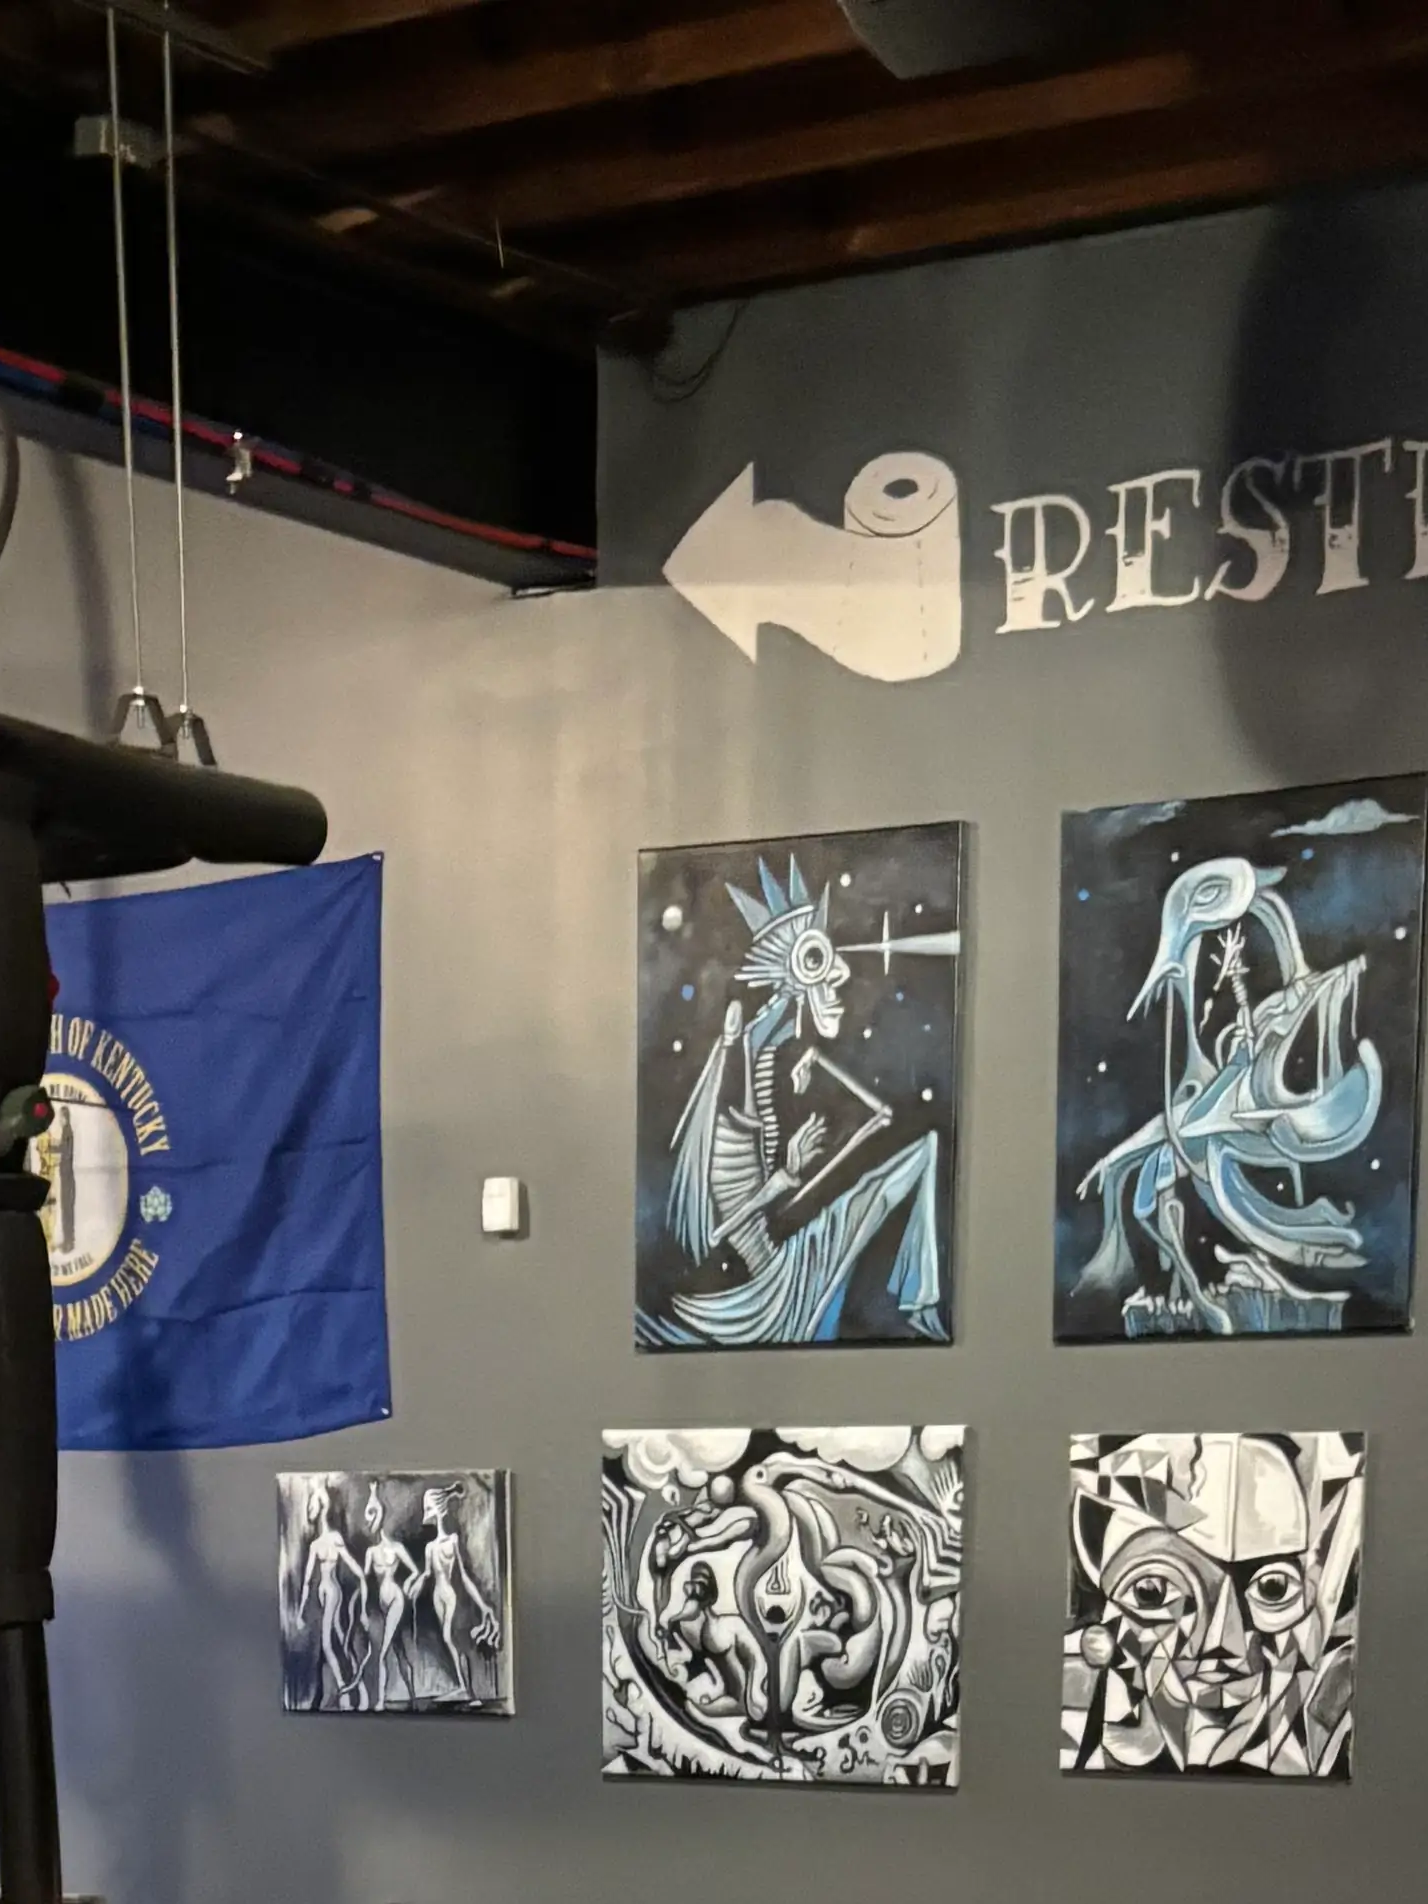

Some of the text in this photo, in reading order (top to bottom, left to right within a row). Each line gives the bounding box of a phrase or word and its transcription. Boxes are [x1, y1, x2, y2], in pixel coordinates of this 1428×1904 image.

[68, 1017, 170, 1156] OF KENTUCKY
[67, 1286, 118, 1342] MADE
[110, 1238, 159, 1311] HERE
